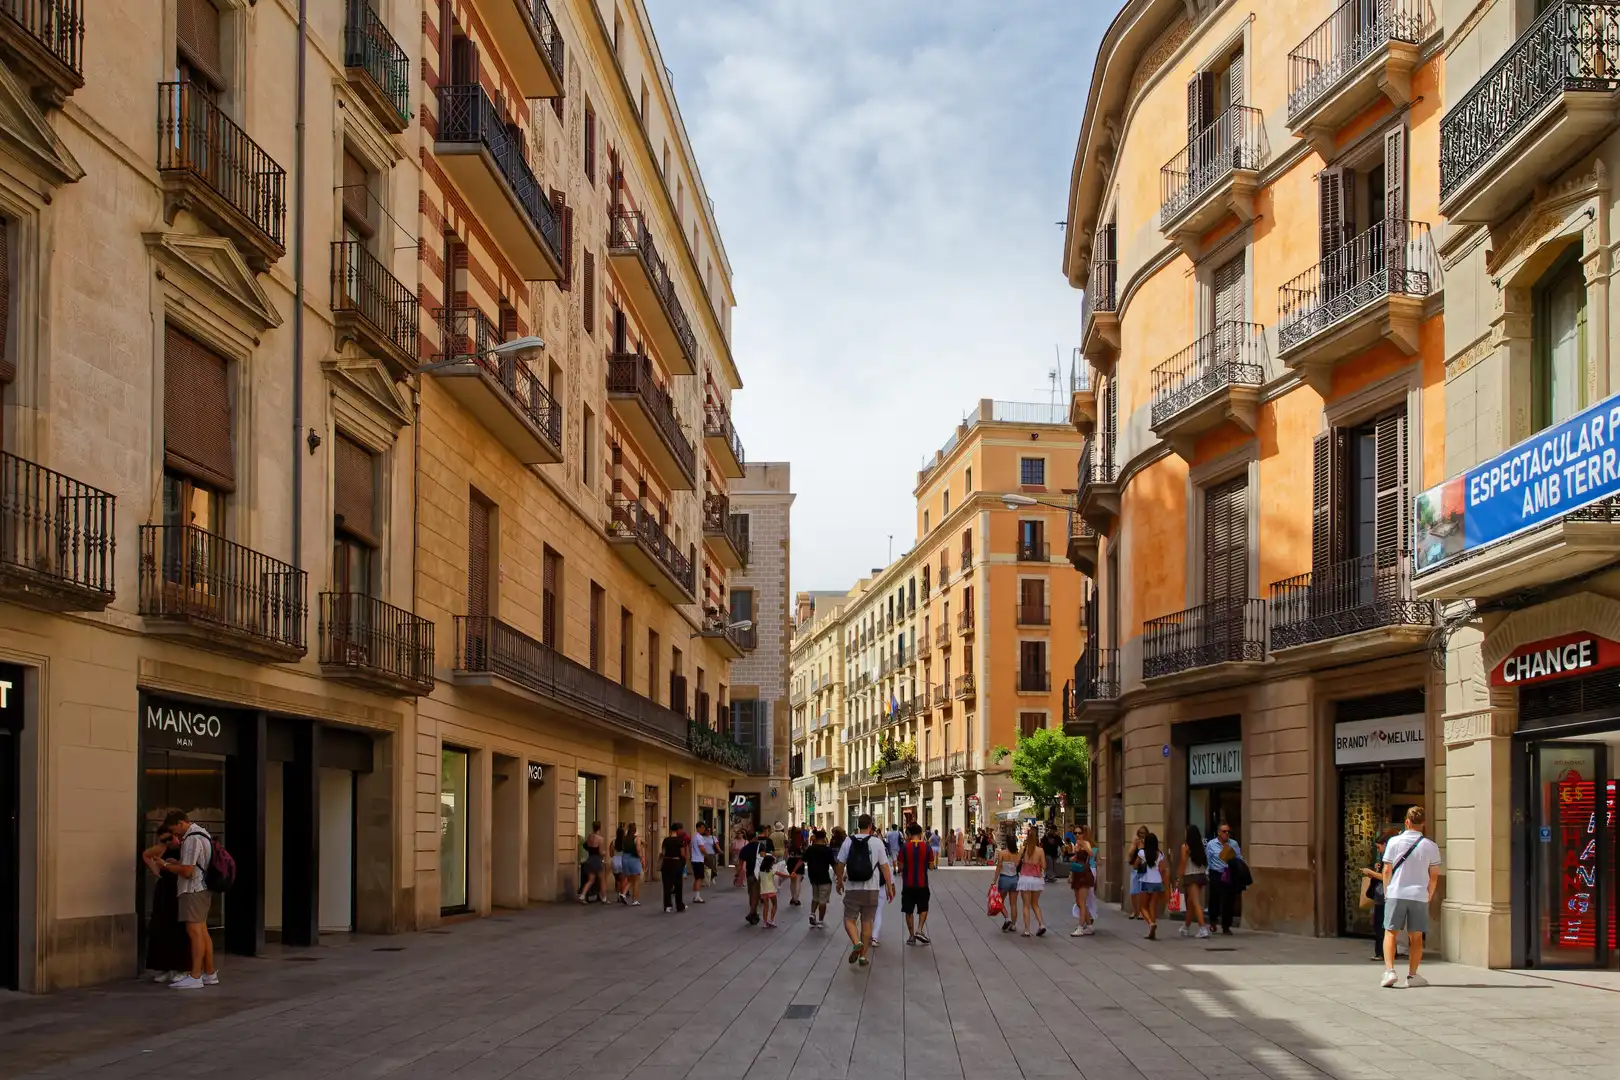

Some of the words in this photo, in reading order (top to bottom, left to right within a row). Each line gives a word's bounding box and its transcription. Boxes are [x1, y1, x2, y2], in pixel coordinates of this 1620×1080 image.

[1470, 415, 1605, 507] ESPECTACULAR
[1521, 474, 1561, 519] AMB
[1563, 447, 1620, 499] TERR
[1503, 640, 1592, 683] CHANGE
[147, 705, 221, 738] MANGO
[176, 738, 193, 746] MAN
[1336, 734, 1369, 750] BRANDY
[731, 794, 747, 806] JD
